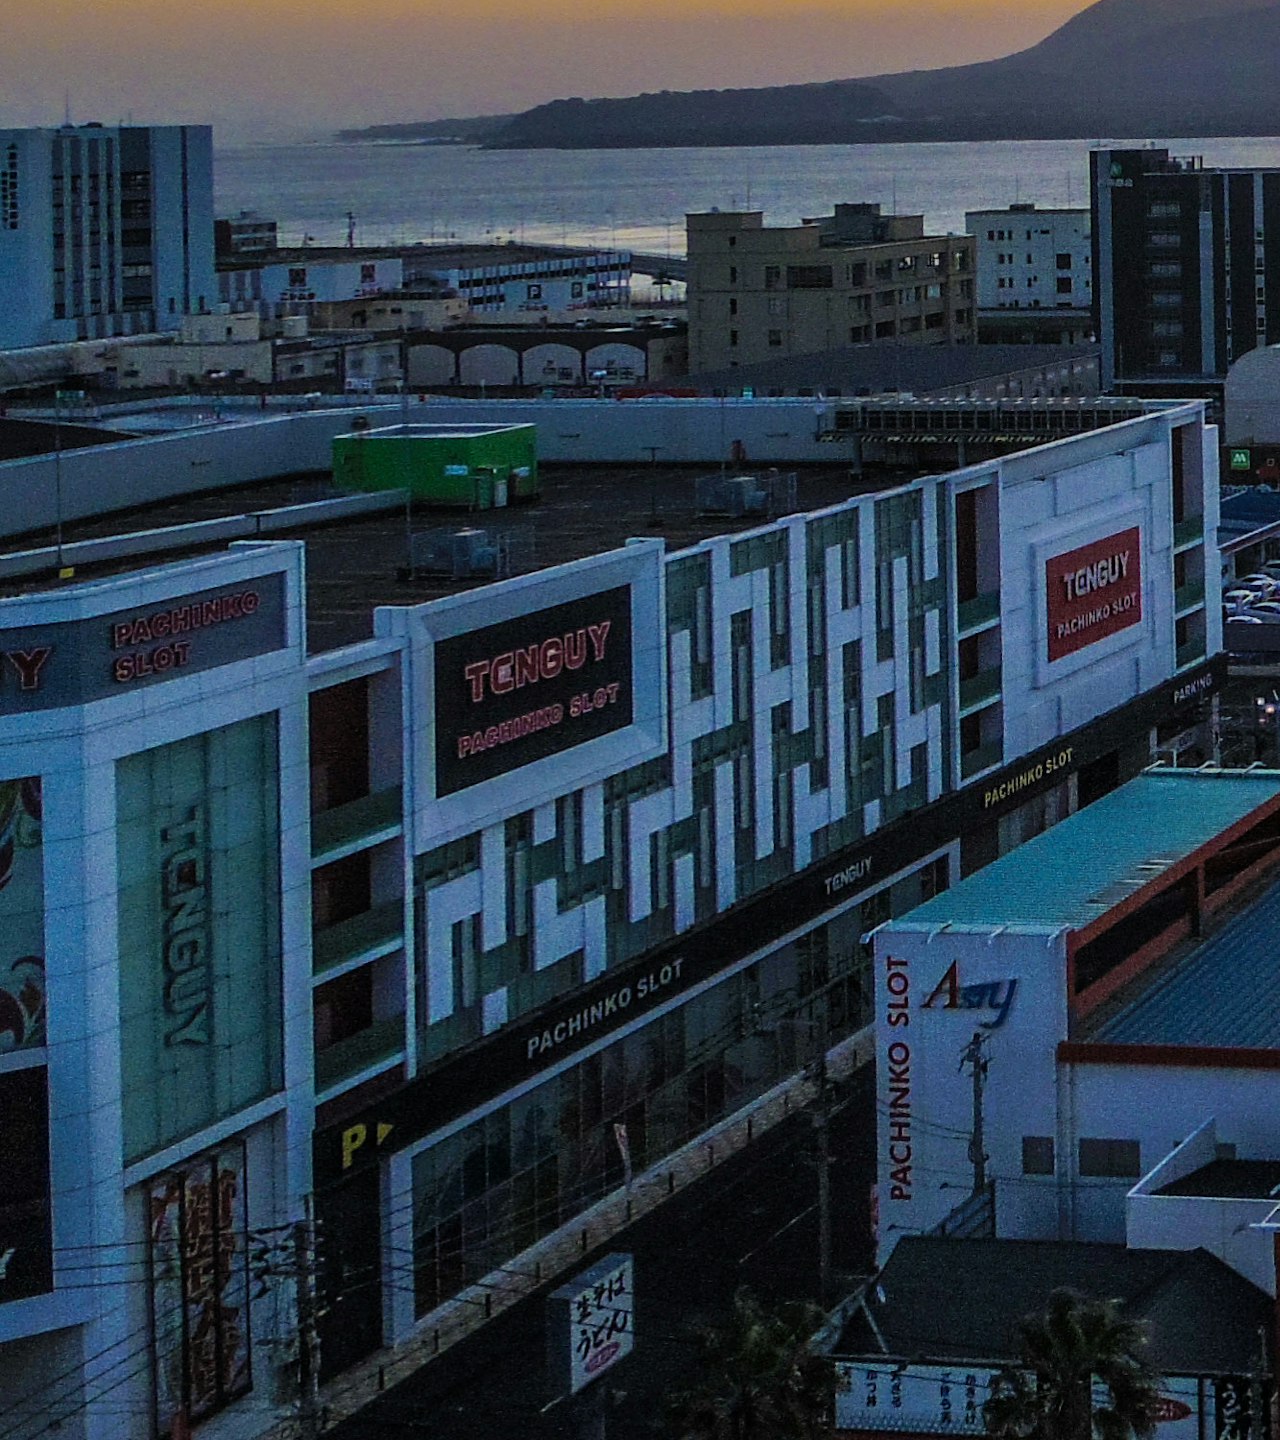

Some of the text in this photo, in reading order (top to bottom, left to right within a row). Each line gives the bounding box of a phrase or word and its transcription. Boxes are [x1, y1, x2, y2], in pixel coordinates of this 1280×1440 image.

[1062, 550, 1130, 602] TENGUY
[113, 589, 262, 650] PACHINKO
[1056, 592, 1137, 640] PACHINKO SLOT
[114, 640, 194, 683] SLOT
[463, 620, 612, 704] TENGUY
[1173, 672, 1213, 704] PARKING
[456, 682, 620, 759] PACHINKO SLOT
[983, 746, 1074, 809] PACHINKO SLOT
[823, 855, 873, 896] TENGUY
[160, 805, 212, 1046] TENGUY
[526, 956, 686, 1060] PACHINKO SLOT
[886, 955, 912, 1201] PACHINKO SLOT
[341, 1122, 368, 1171] P
[576, 1271, 626, 1325] 生そば
[576, 1311, 628, 1361] うどん
